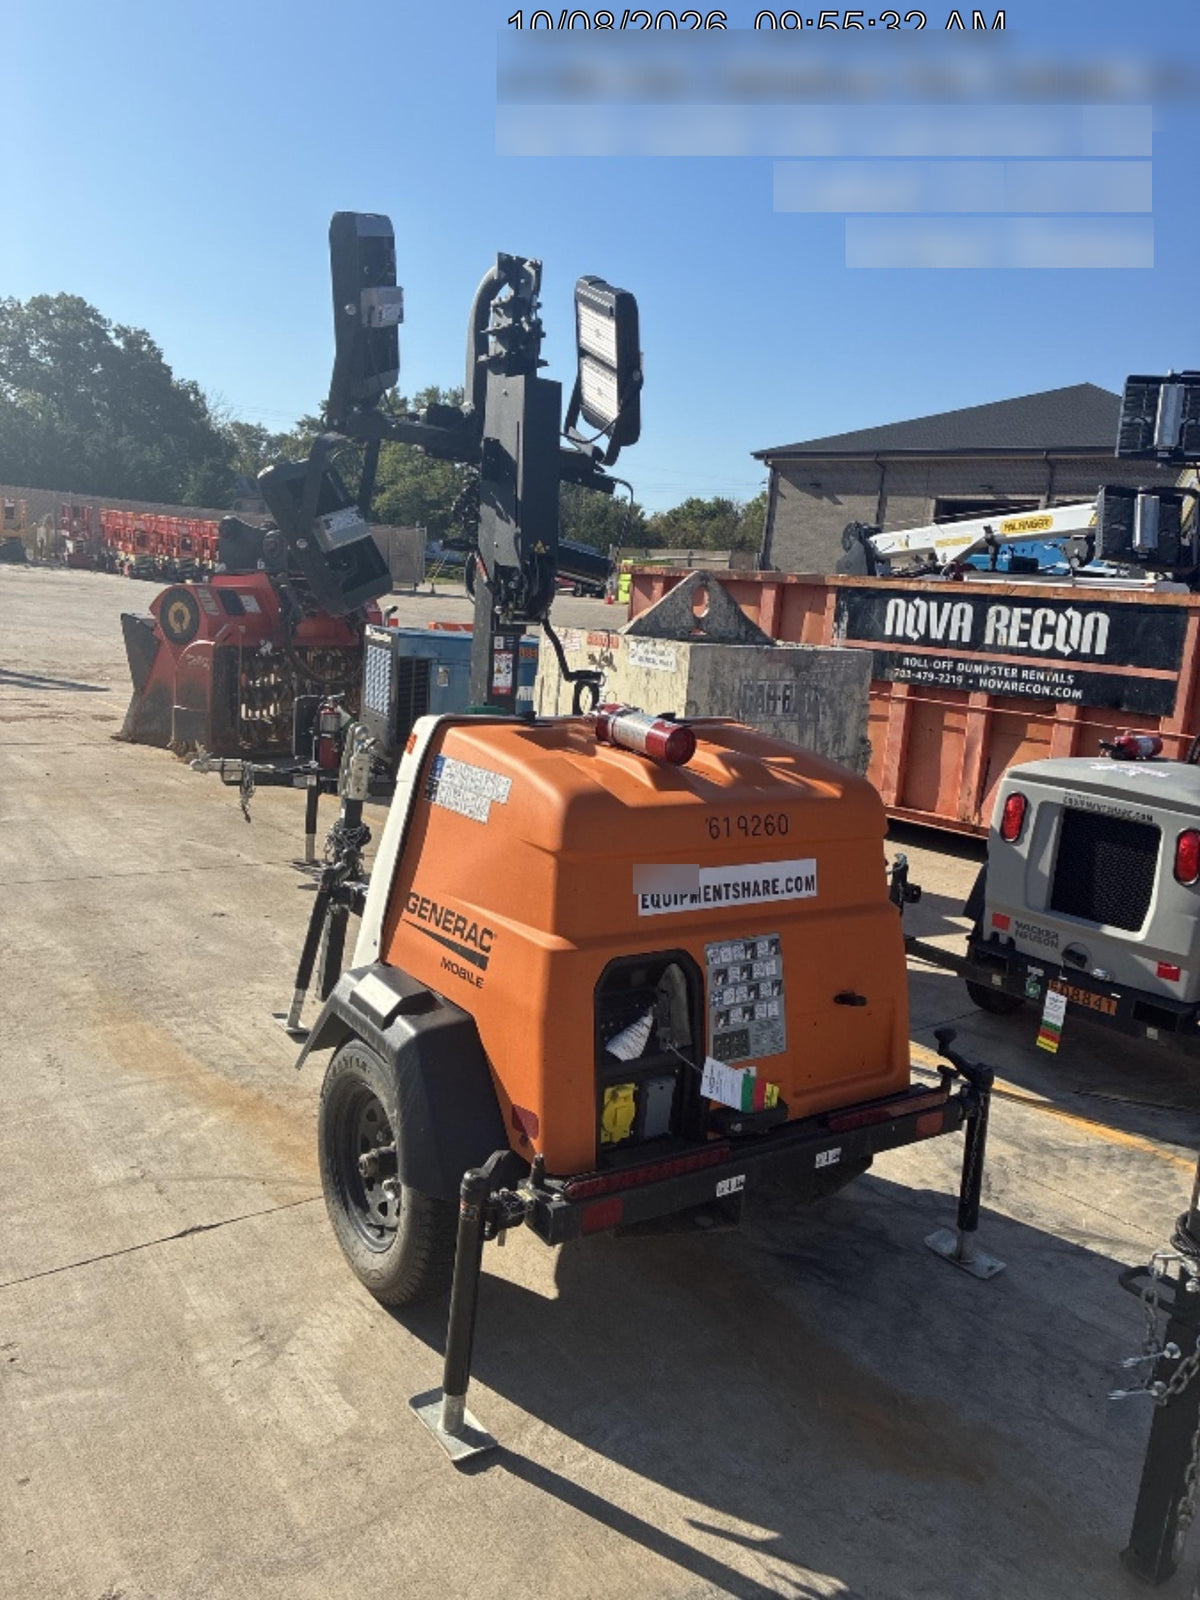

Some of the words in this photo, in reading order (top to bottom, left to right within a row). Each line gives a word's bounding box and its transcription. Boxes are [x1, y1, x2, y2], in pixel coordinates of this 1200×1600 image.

[884, 597, 974, 643] NOVA
[984, 604, 1110, 657] RECON
[957, 662, 1018, 679] DUMPSTER
[1021, 669, 1075, 685] RENTALS
[979, 678, 1084, 700] NOVARECON.COM
[708, 813, 789, 840] 619260
[405, 892, 493, 954] GENERAC
[440, 956, 484, 989] MOBILE
